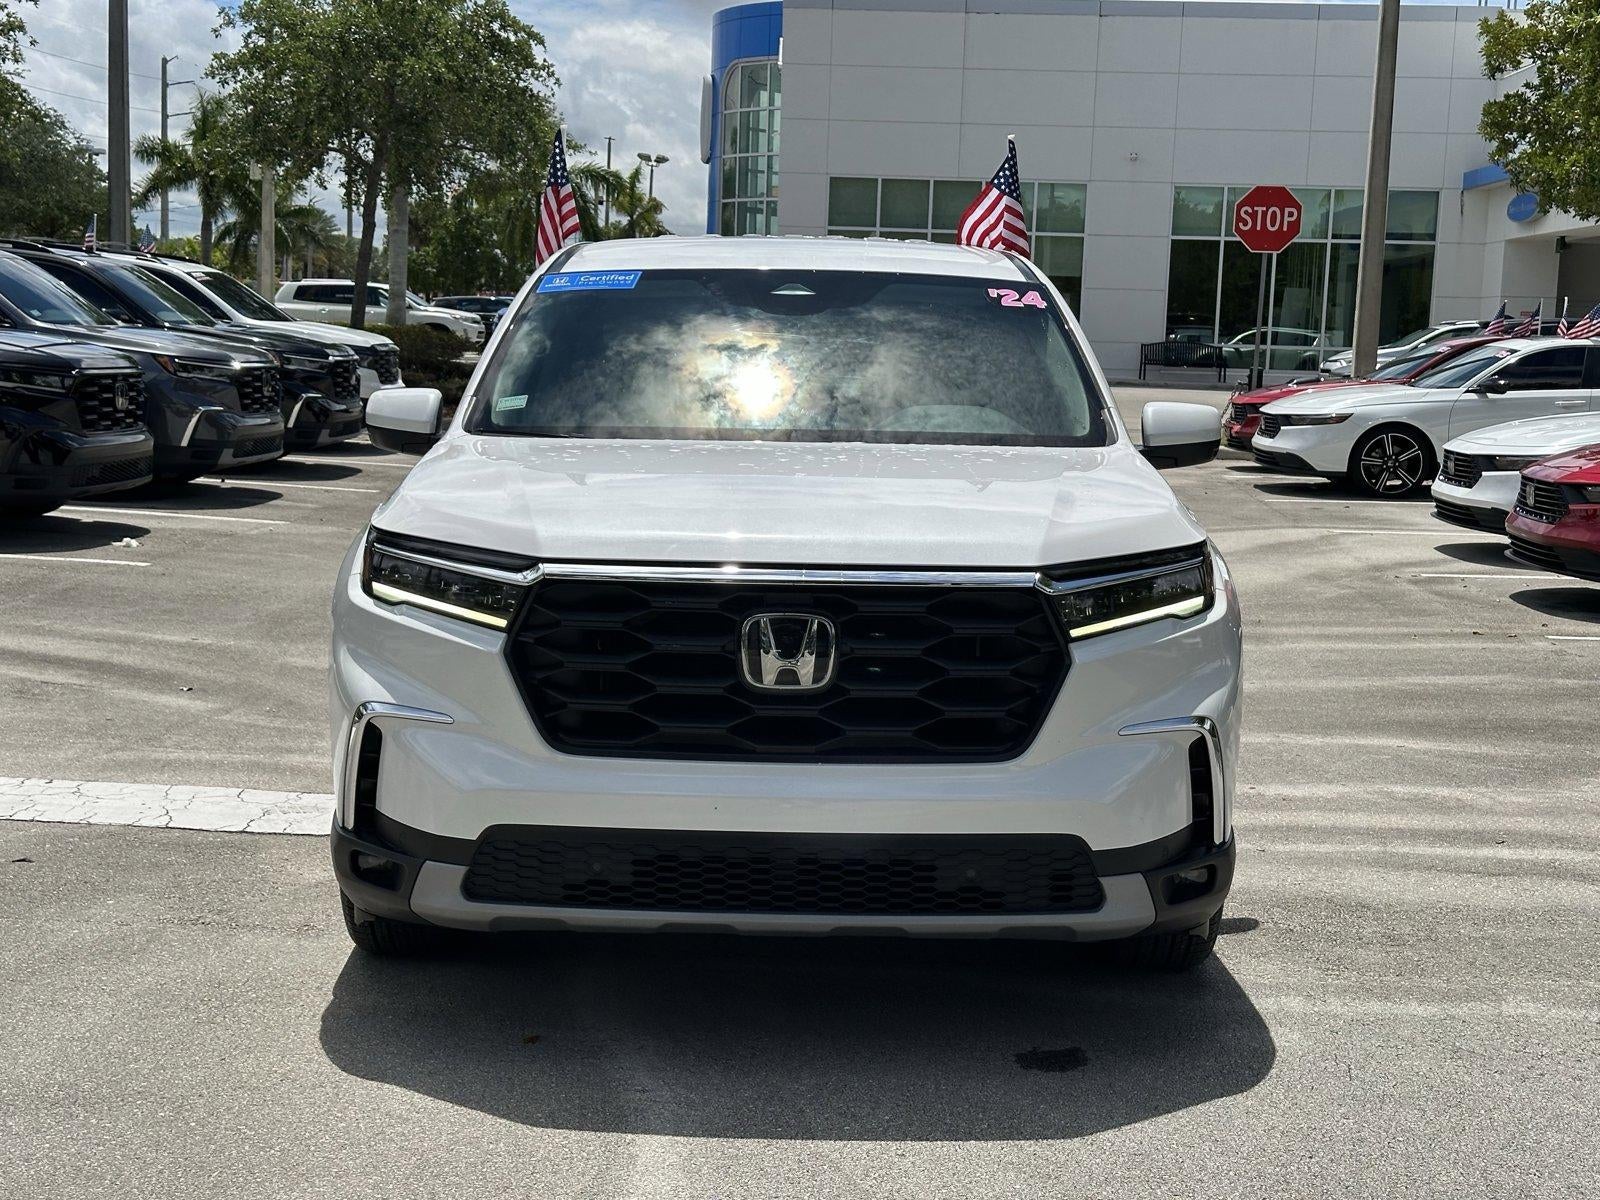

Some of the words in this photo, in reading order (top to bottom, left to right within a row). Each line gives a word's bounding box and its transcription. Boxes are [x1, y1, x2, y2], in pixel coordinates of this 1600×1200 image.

[1238, 206, 1298, 232] STOP
[580, 274, 634, 282] Certified
[987, 288, 1048, 309] '24
